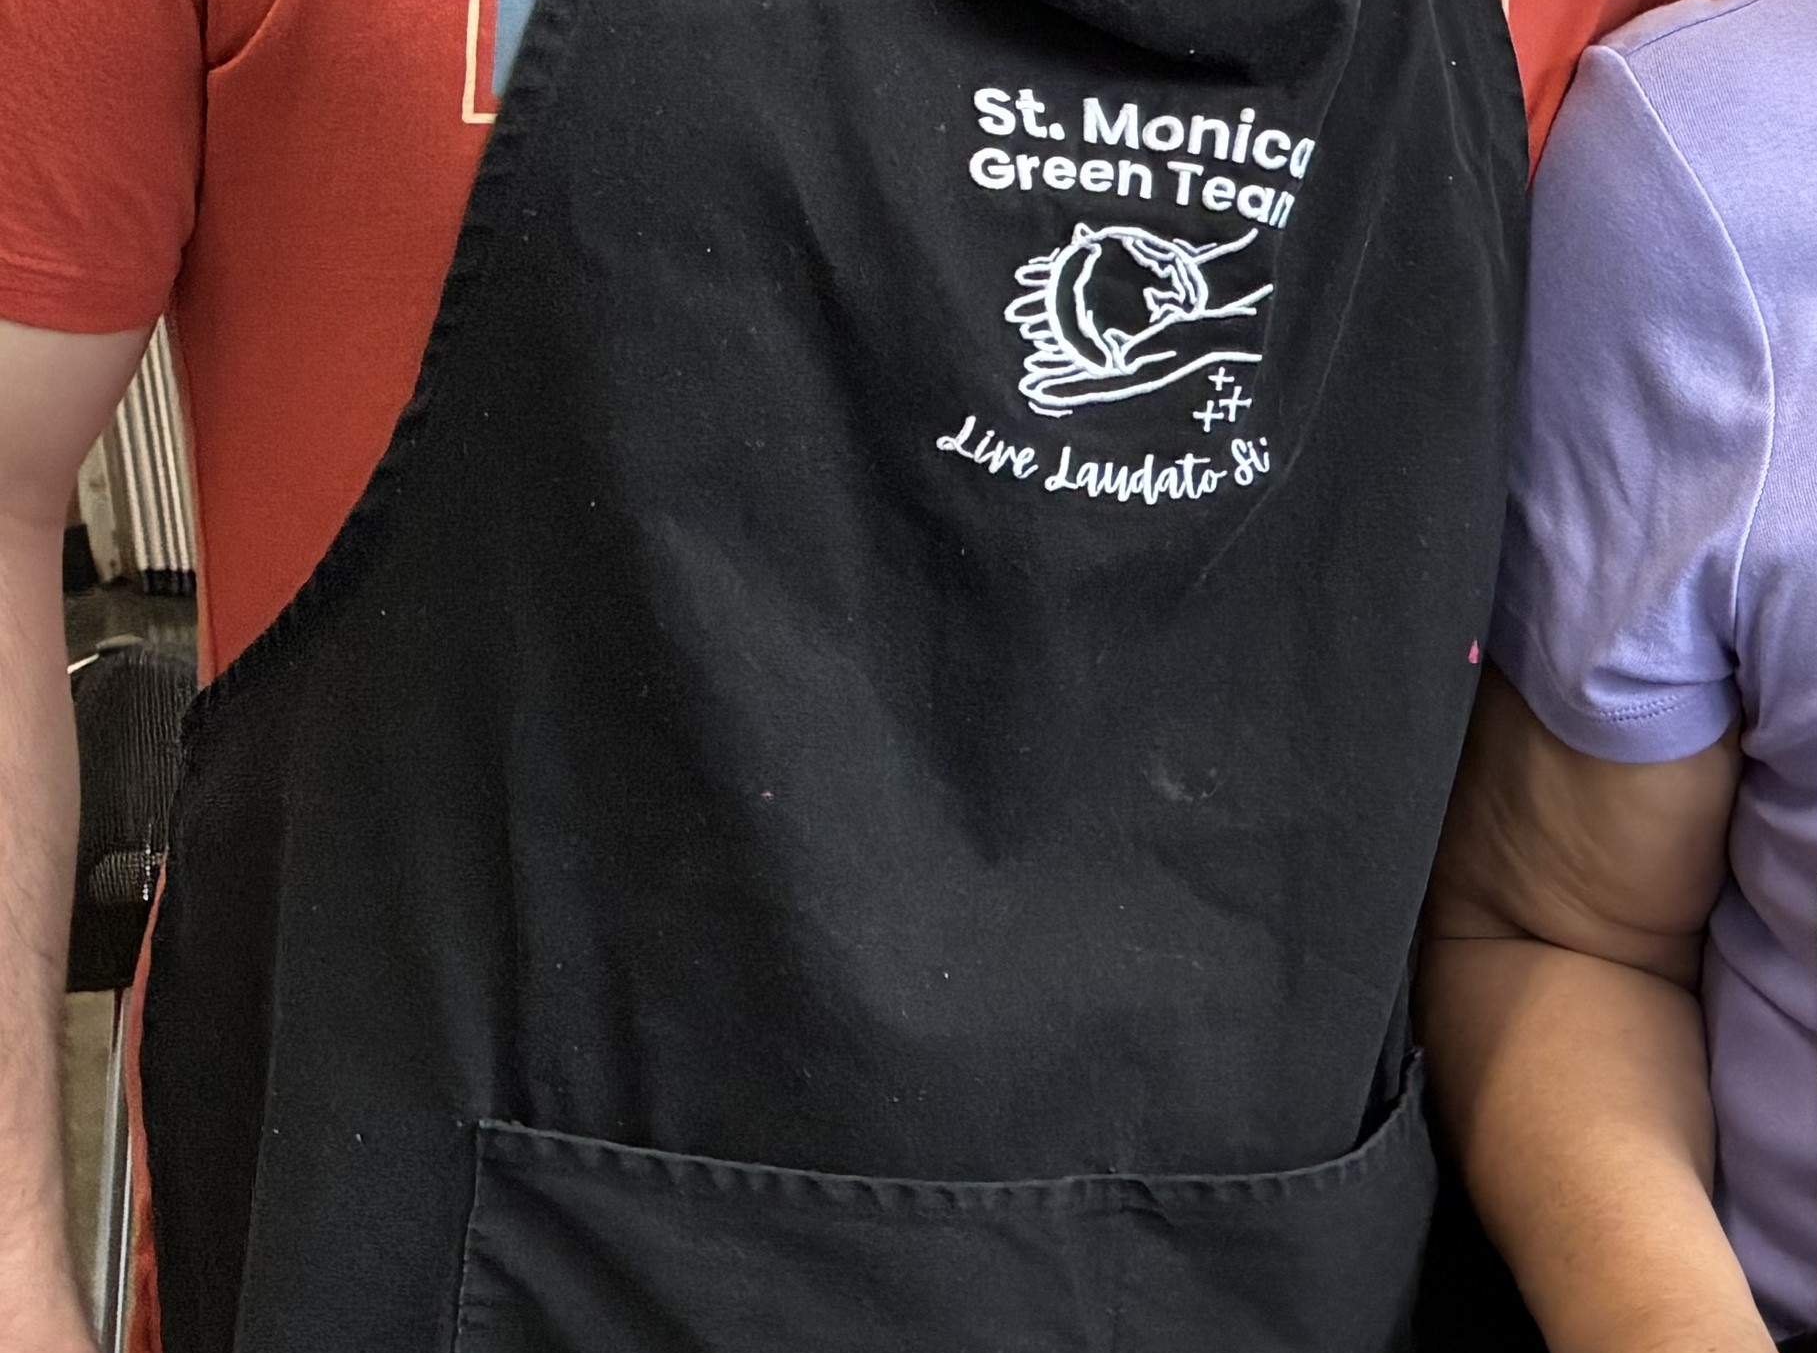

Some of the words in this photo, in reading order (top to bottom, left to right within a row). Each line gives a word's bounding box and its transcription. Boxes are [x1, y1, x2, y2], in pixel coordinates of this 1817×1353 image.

[968, 146, 1153, 199] Green
[973, 87, 1065, 141] St.
[1082, 97, 1316, 179] Monica
[936, 415, 1039, 480] Live
[1044, 445, 1228, 506] Laudato
